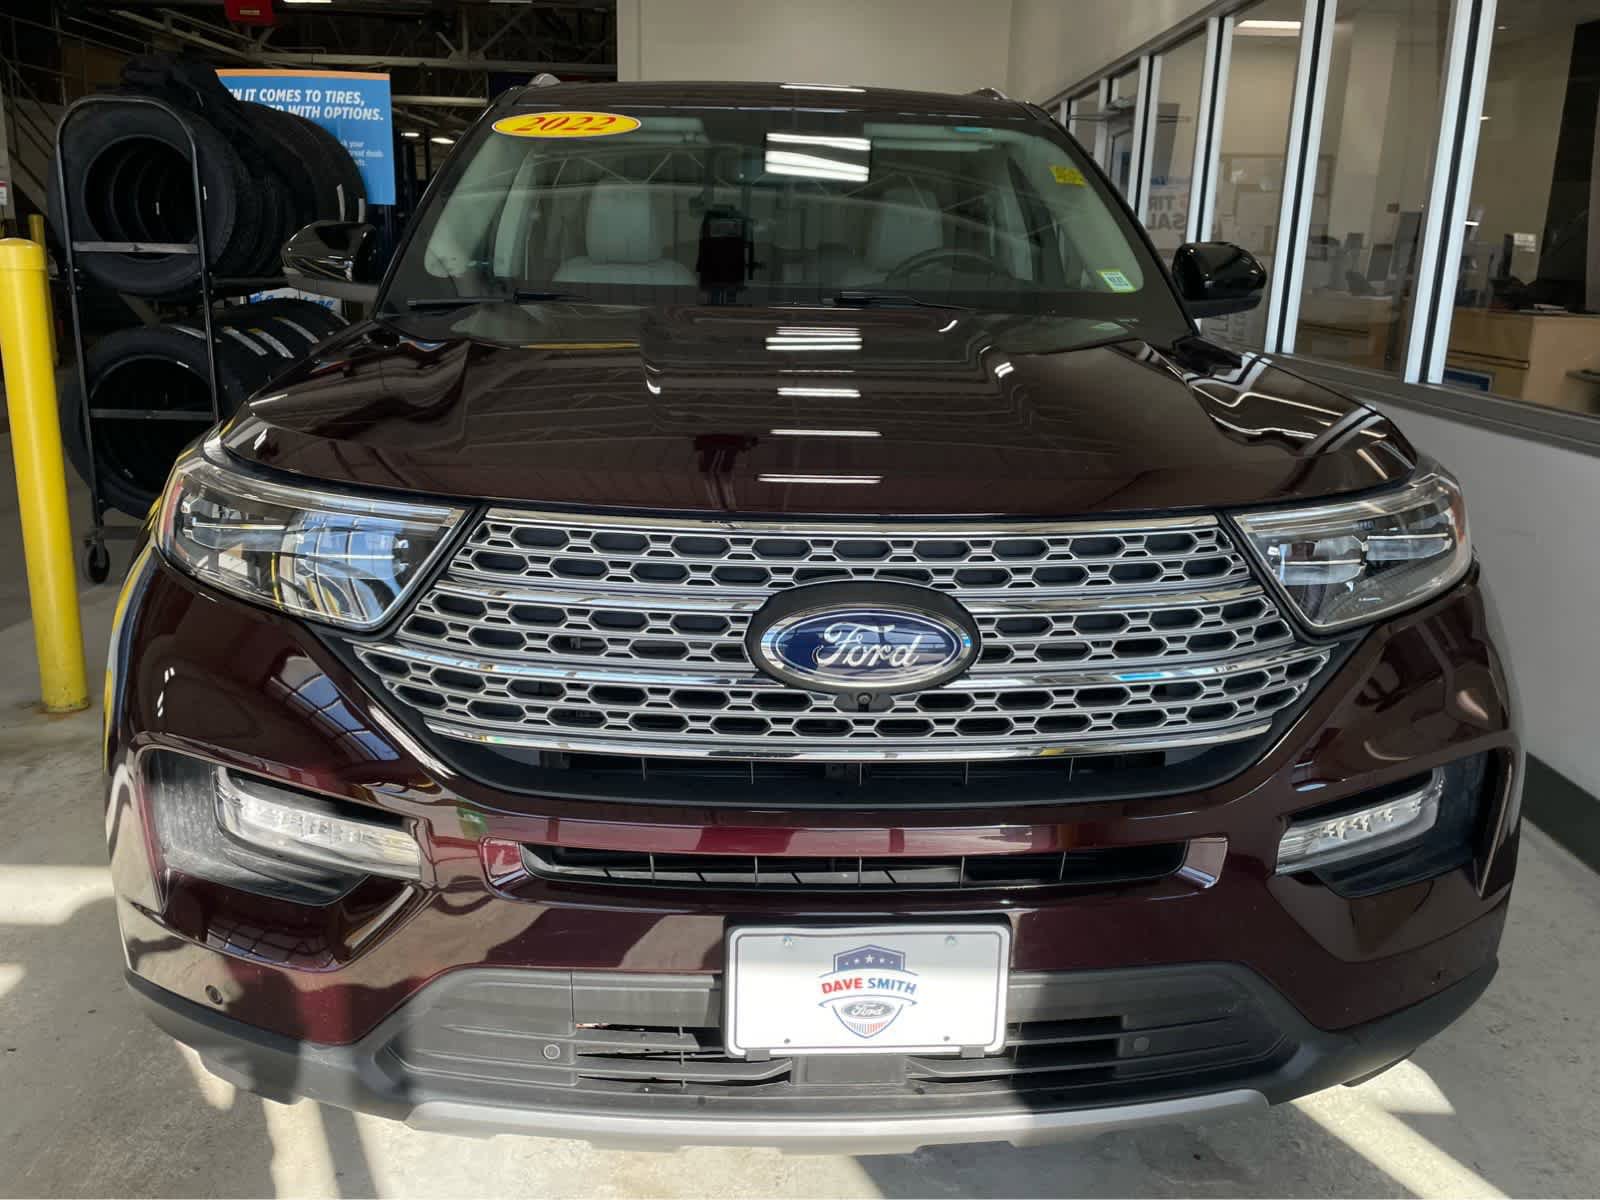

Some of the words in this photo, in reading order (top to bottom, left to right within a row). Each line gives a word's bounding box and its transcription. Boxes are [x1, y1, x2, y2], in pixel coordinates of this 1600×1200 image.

[245, 88, 257, 102] IT
[259, 88, 302, 103] COMES
[305, 89, 322, 103] TO
[325, 90, 366, 107] TIRES,
[288, 105, 321, 119] WITH
[323, 106, 385, 121] OPTIONS.
[512, 116, 617, 132] 2022
[812, 621, 922, 668] Ford
[821, 977, 863, 994] DAVE
[866, 977, 917, 995] SMITH
